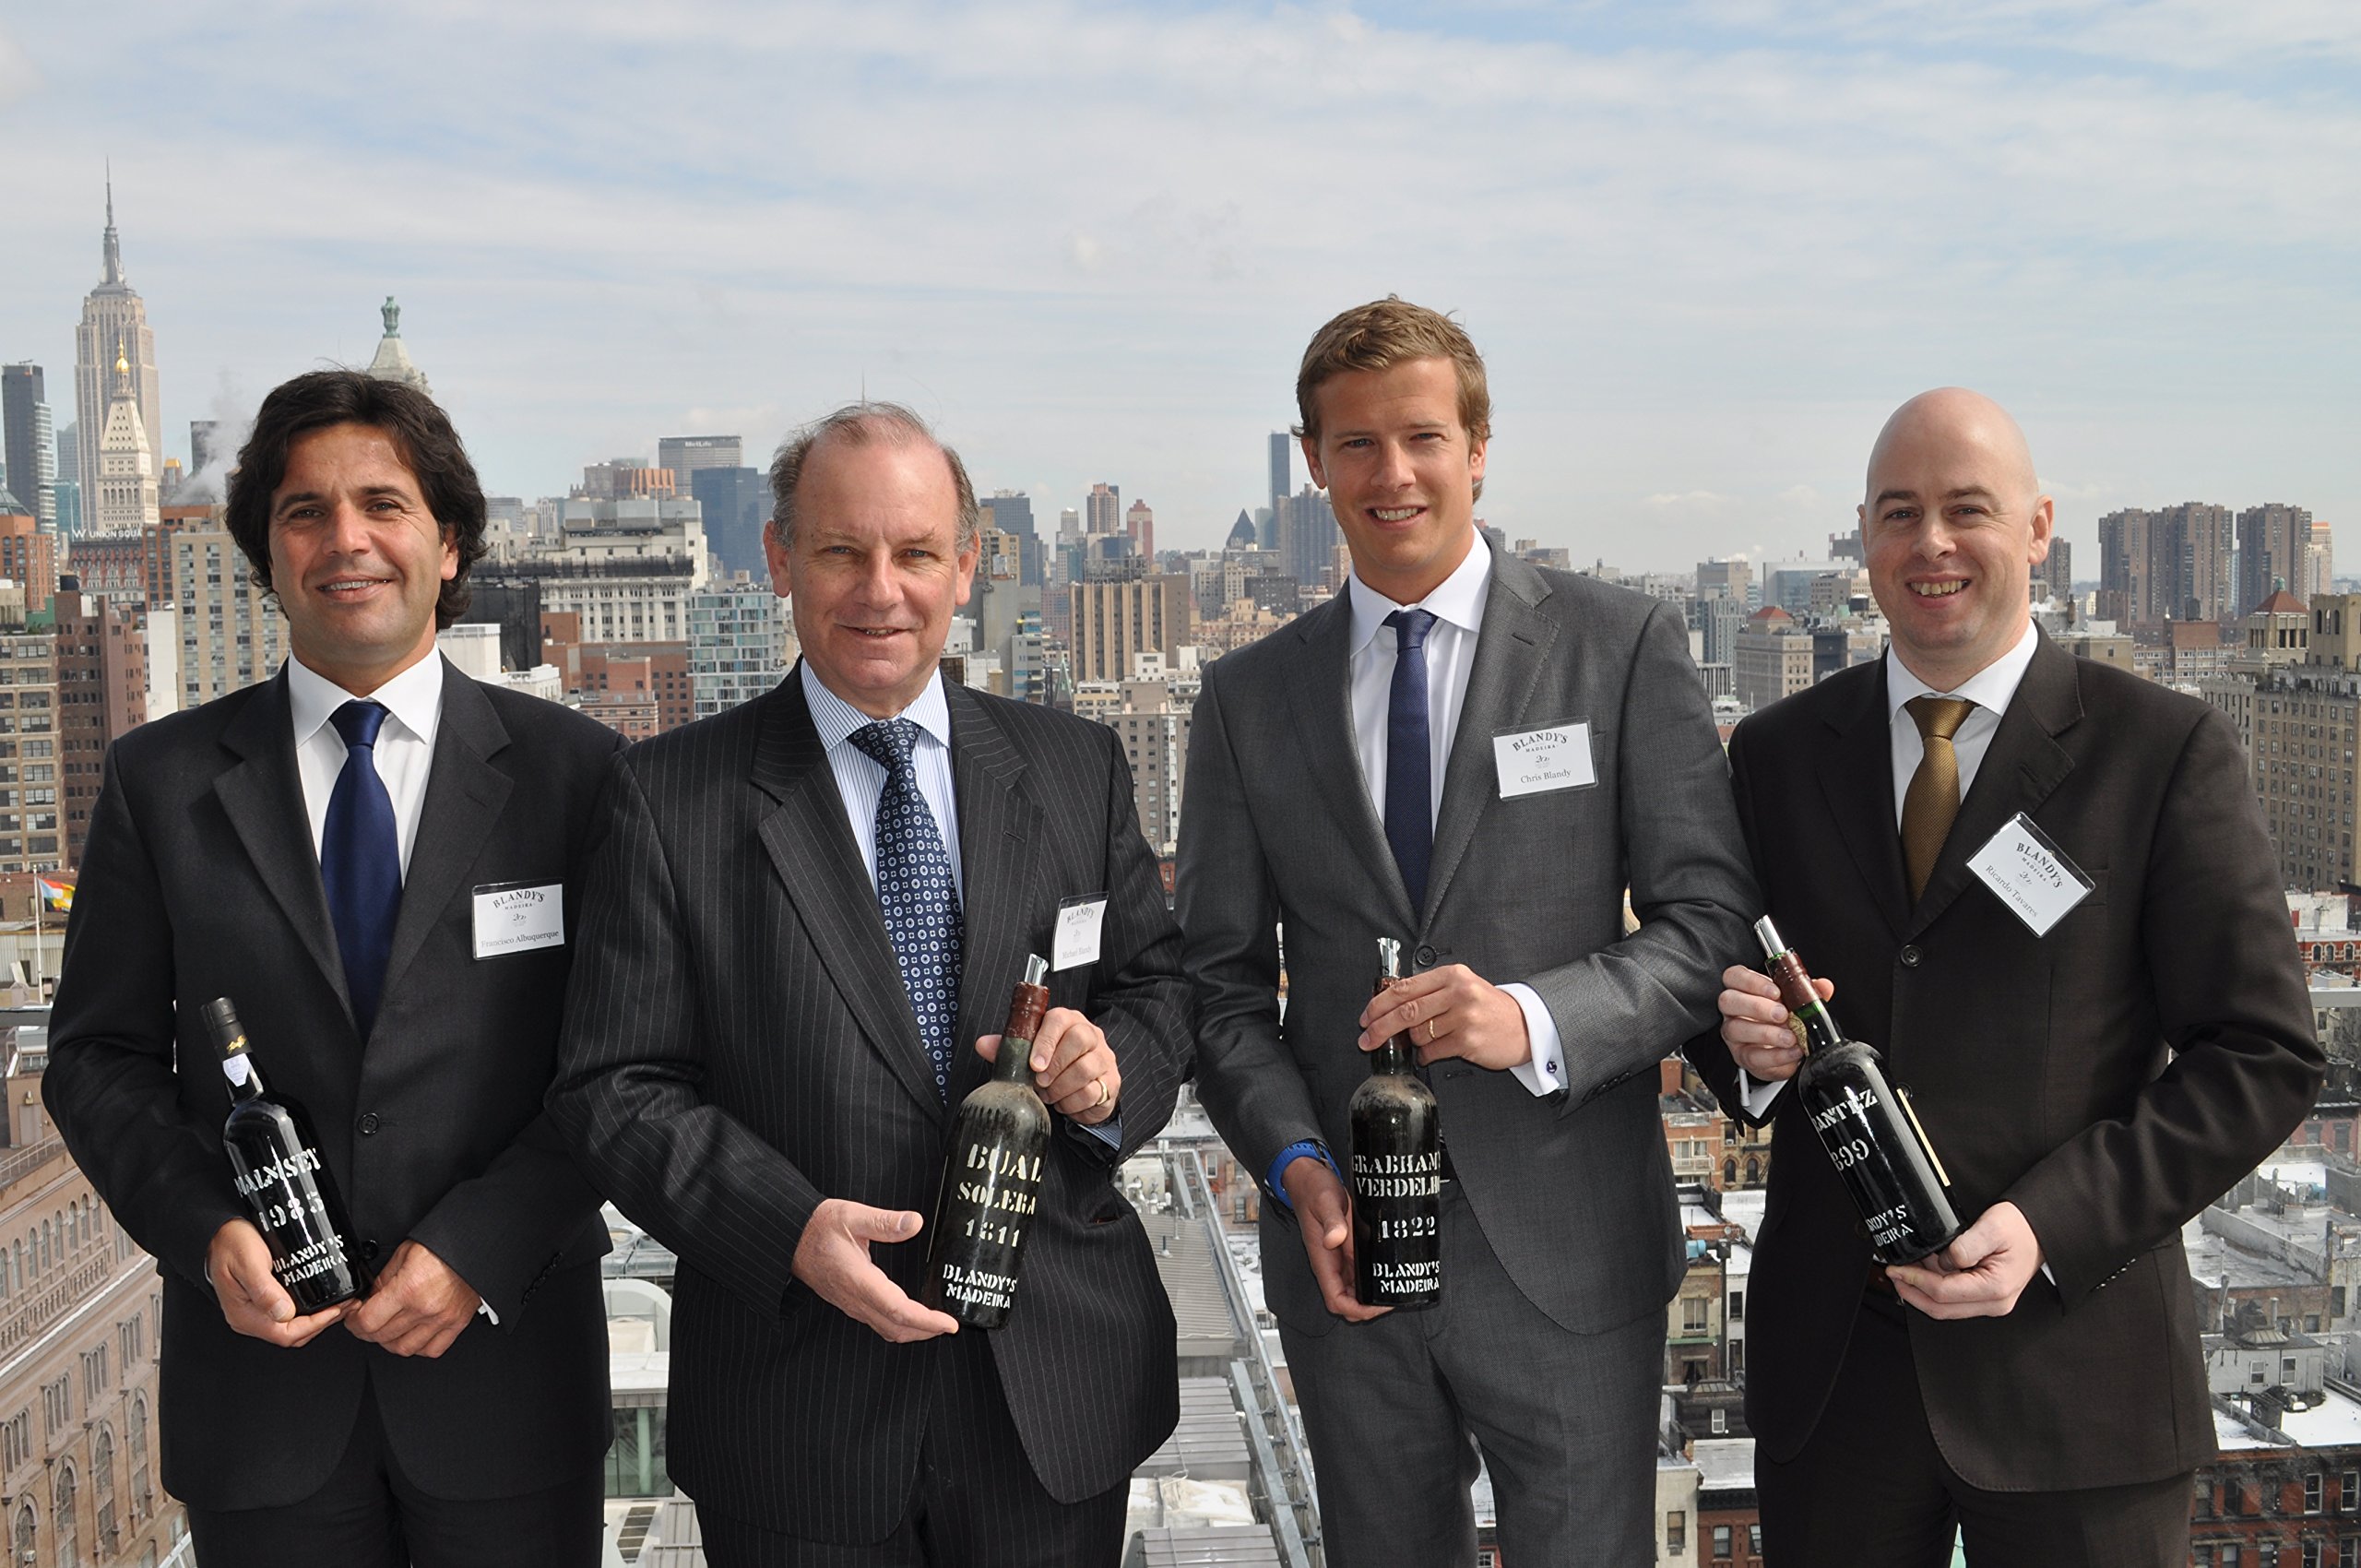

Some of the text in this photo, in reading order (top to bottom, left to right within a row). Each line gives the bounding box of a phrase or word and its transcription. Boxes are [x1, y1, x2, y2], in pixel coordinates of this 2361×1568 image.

[89, 529, 117, 539] UNION
[118, 529, 142, 538] SQUA
[1513, 731, 1568, 752] BLANDY'S
[1525, 744, 1557, 753] MADEIRA
[1520, 768, 1572, 784] Chris Blandy
[2016, 842, 2063, 889] BLANDY'S
[2022, 857, 2047, 883] MADEIRA
[492, 890, 545, 909] BLANDY'S
[1986, 864, 2038, 919] Ricardo Tavares
[481, 931, 560, 948] Francisco Albuquerque
[967, 1143, 1042, 1183] BUAL
[1352, 1150, 1441, 1174] GRABHAM
[1830, 1138, 1869, 1171] 899
[233, 1147, 322, 1198] MALMSEY
[957, 1182, 1037, 1216] SOLERA
[1356, 1175, 1441, 1197] VERDELH
[258, 1191, 325, 1232] 1985
[965, 1218, 1021, 1248] 1811
[1382, 1216, 1436, 1240] 1822
[1873, 1223, 1914, 1247] DEIRA
[272, 1234, 345, 1274] BLANDY'S
[282, 1251, 350, 1287] MADEIRA
[943, 1264, 1018, 1293] BLANDY'S
[1372, 1260, 1441, 1278] BLANDY'S
[945, 1283, 1012, 1310] MADEIRA
[1381, 1277, 1440, 1294] MADEIRA
